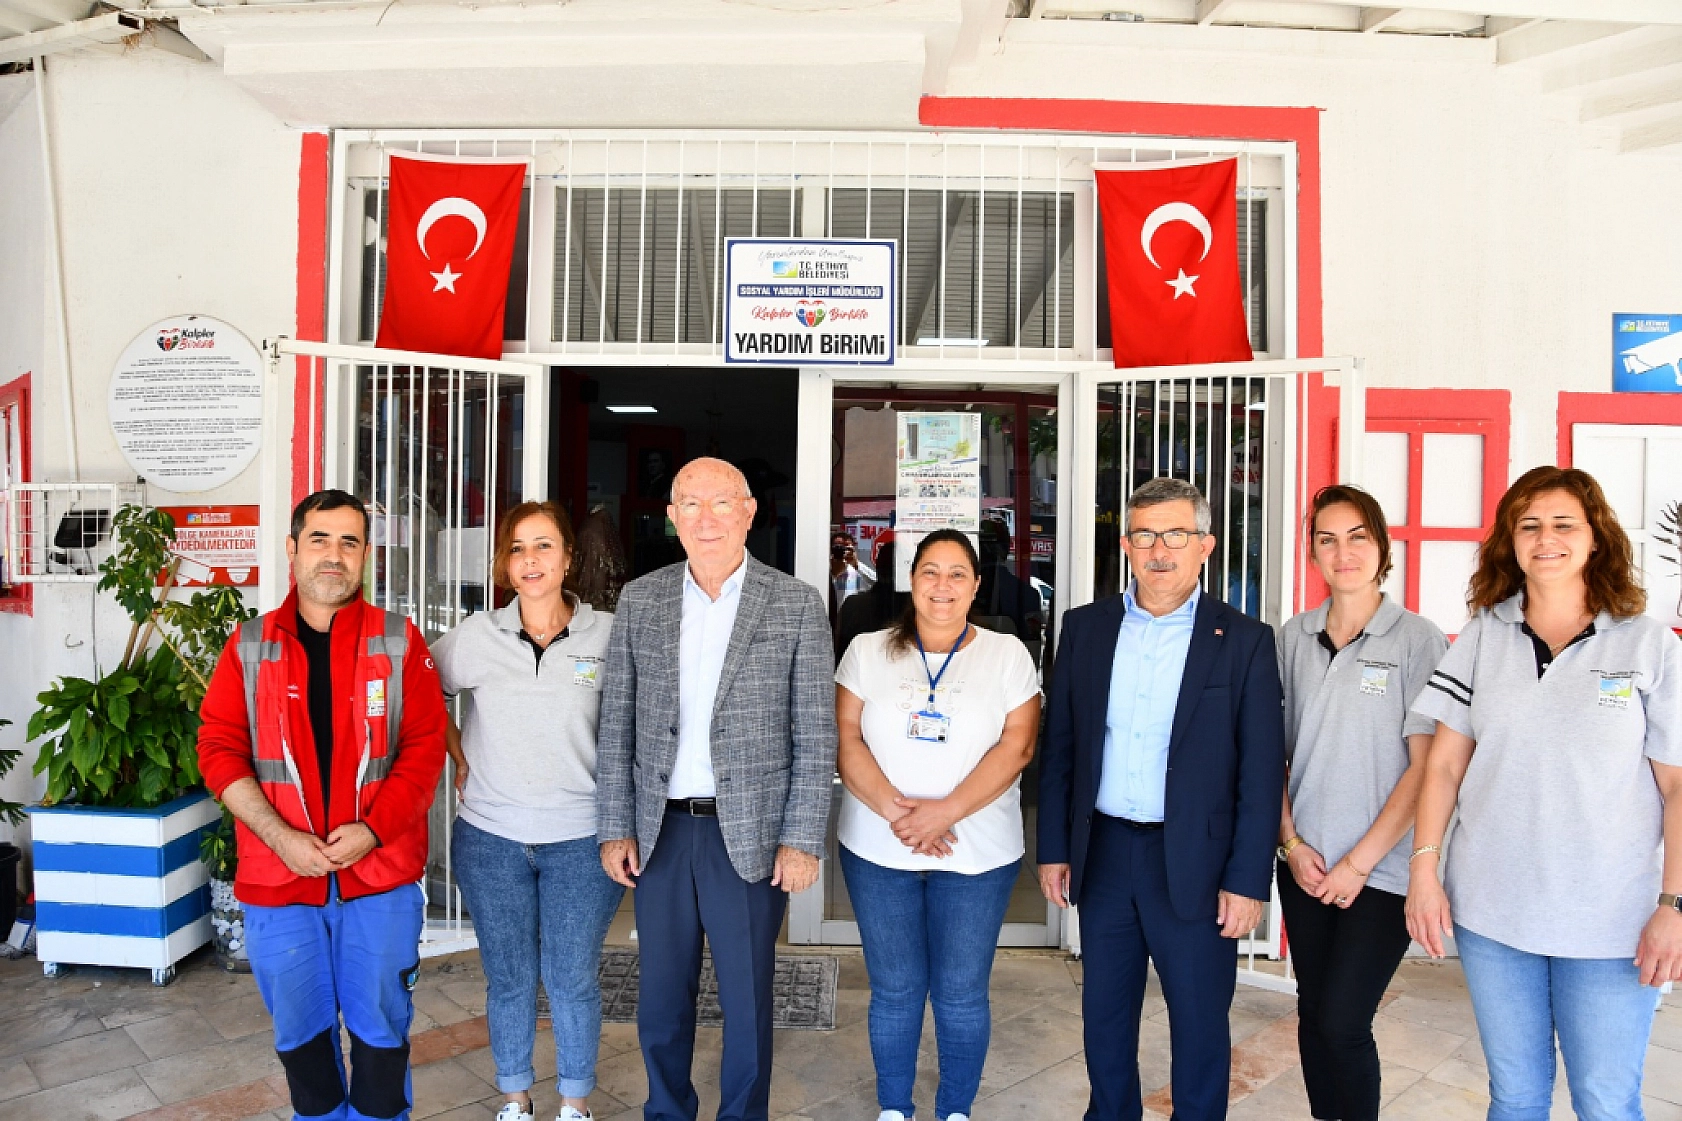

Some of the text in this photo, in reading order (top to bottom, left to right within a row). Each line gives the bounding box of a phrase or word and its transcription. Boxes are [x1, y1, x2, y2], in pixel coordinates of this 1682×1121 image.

[740, 285, 771, 295] SOSYAL
[773, 286, 803, 296] YARDIM
[751, 305, 869, 321] Kalpler Birlikte
[181, 328, 216, 340] Kalpler
[734, 333, 813, 354] YARDIM
[199, 528, 244, 539] KAMERALAR
[168, 538, 256, 551] AYDEDİLMEKTEDİR
